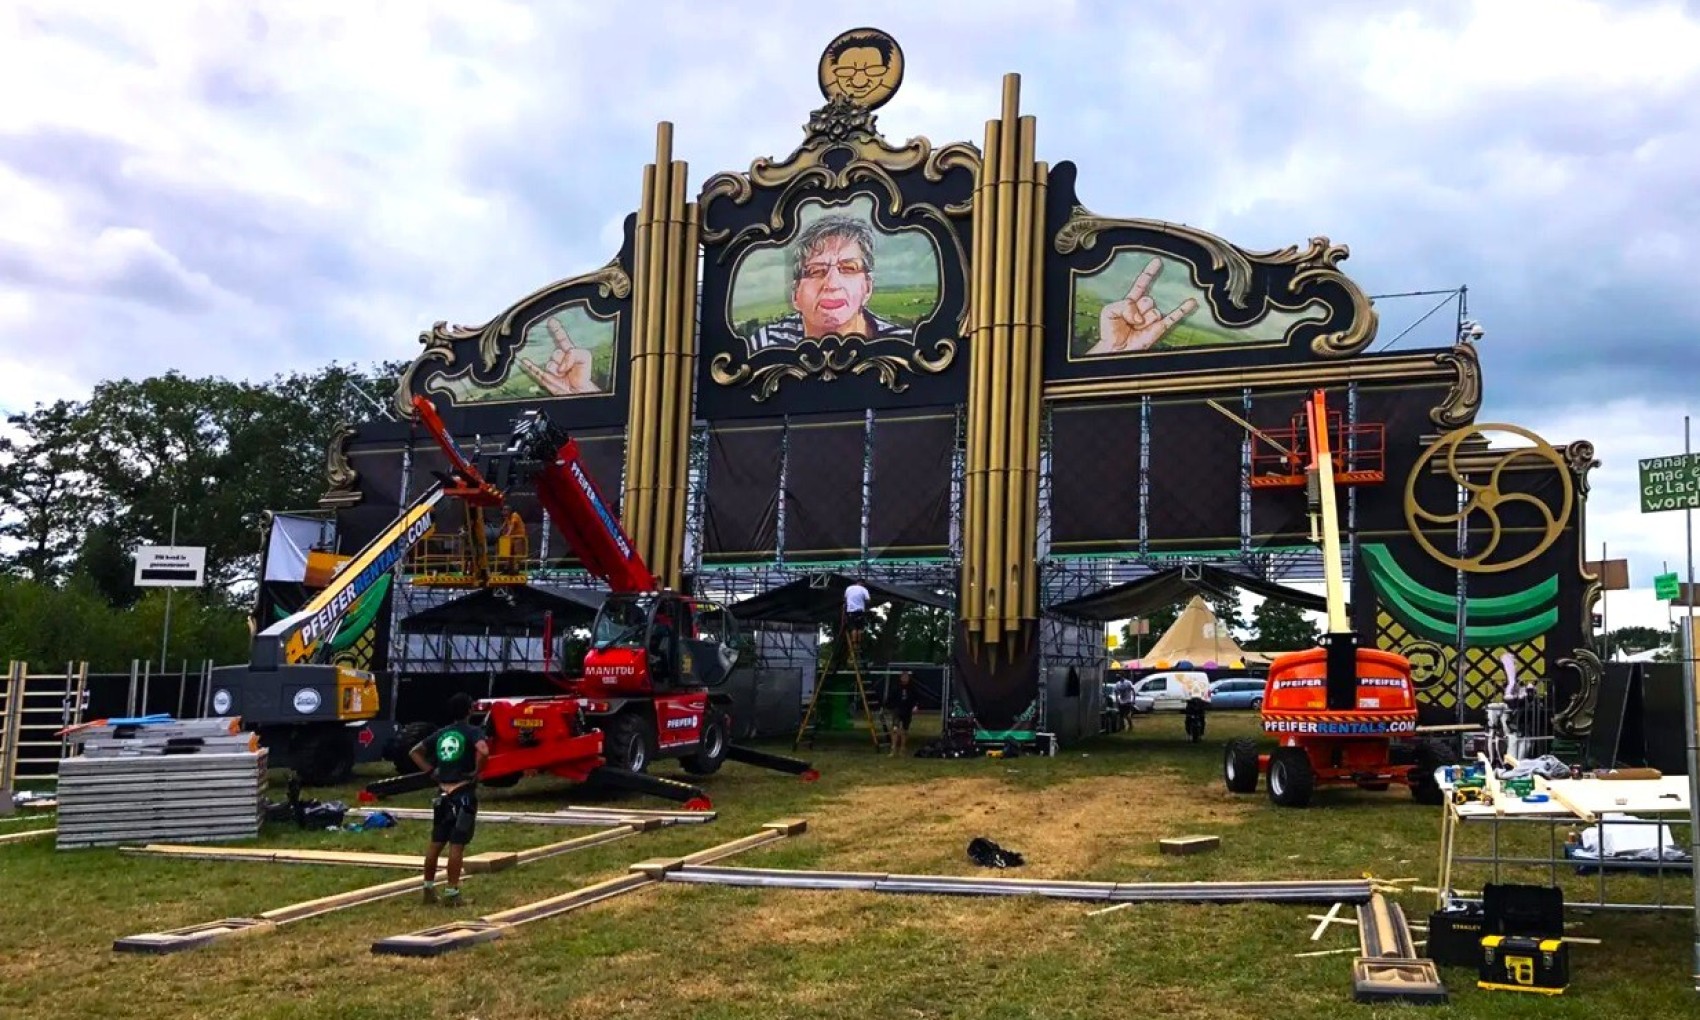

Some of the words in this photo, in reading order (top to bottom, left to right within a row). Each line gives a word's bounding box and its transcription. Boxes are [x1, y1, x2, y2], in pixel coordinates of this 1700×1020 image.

[585, 666, 635, 676] MANITOU
[1279, 678, 1322, 688] PFEIFER
[1360, 677, 1402, 687] PFEIFER
[1264, 720, 1416, 734] PFEIFERRENTALS.COM
